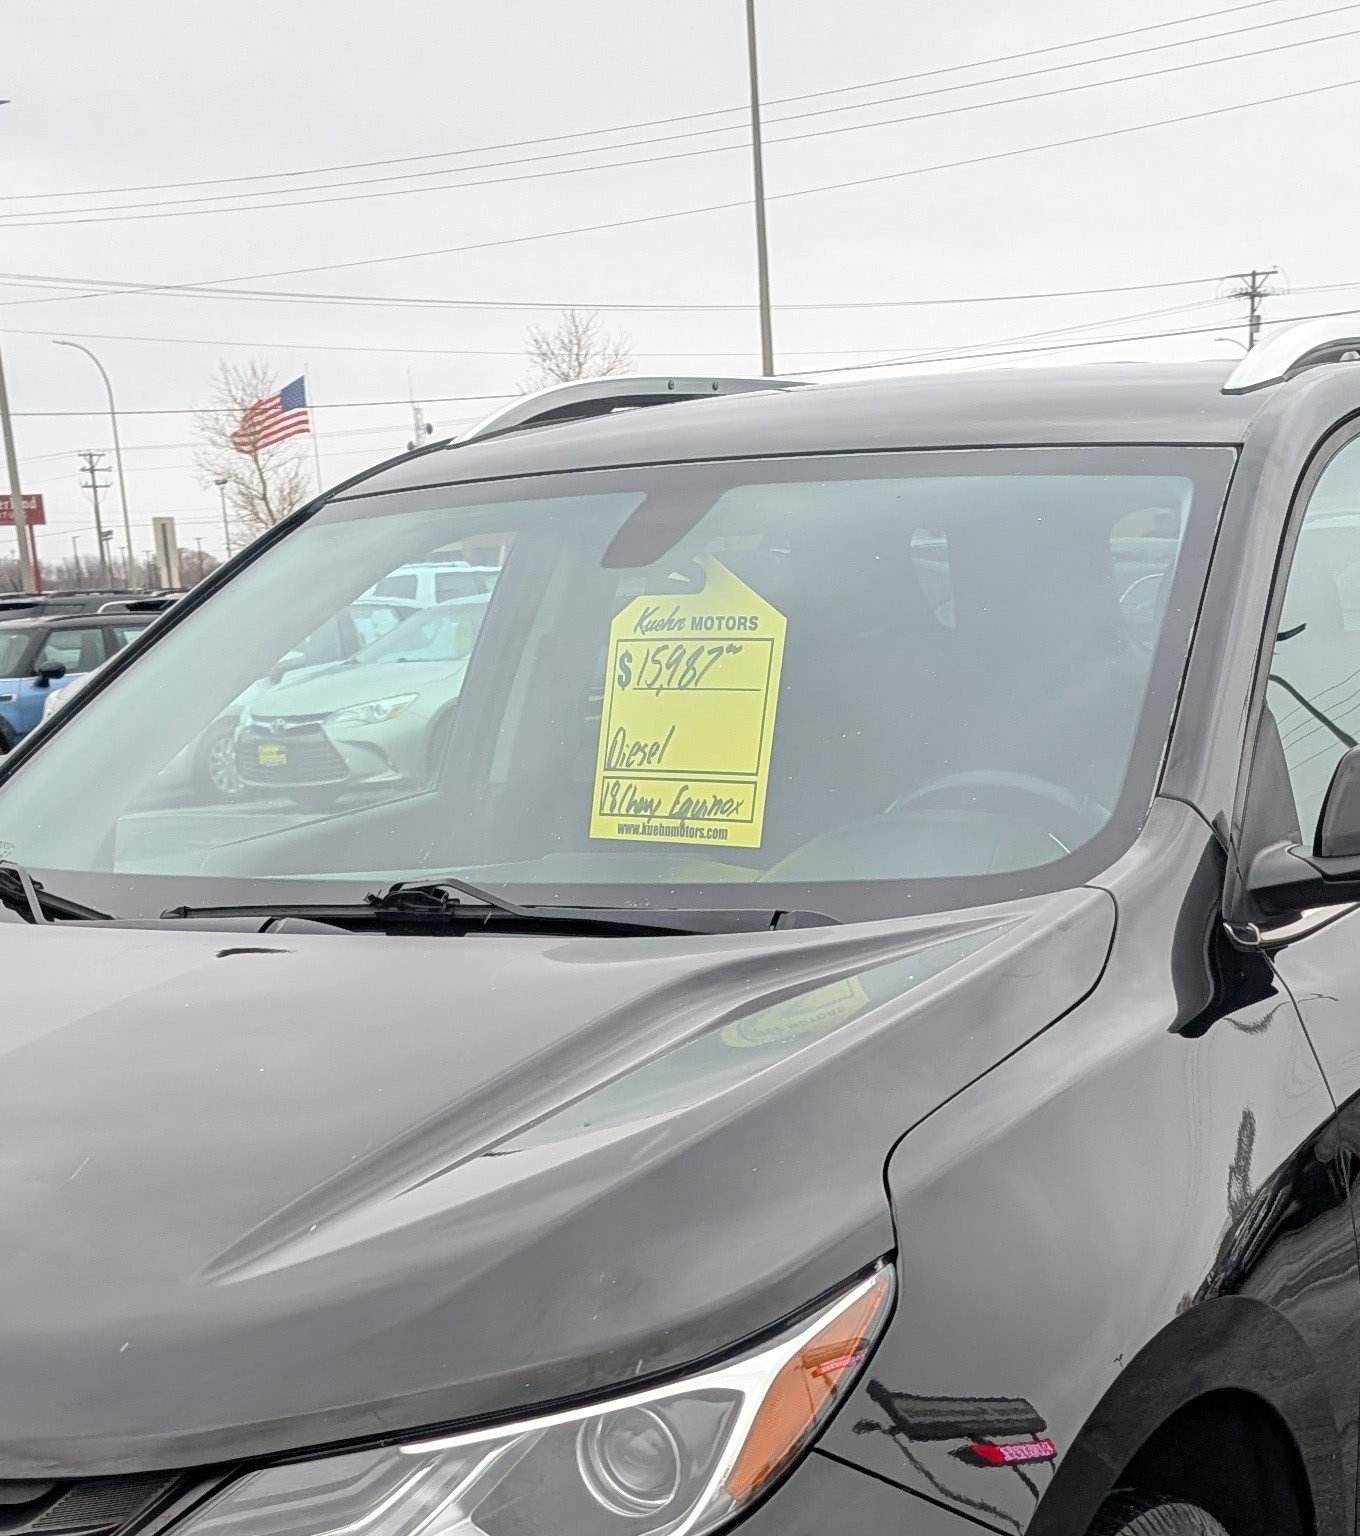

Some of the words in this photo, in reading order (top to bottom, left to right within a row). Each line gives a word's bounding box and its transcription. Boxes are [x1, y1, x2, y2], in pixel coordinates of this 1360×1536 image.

[633, 605, 687, 635] Kuehn
[690, 615, 759, 632] MOTORS
[605, 725, 676, 769] Diesel
[669, 784, 744, 826] Equinox
[617, 822, 729, 841] www.kuehnmotors.com
